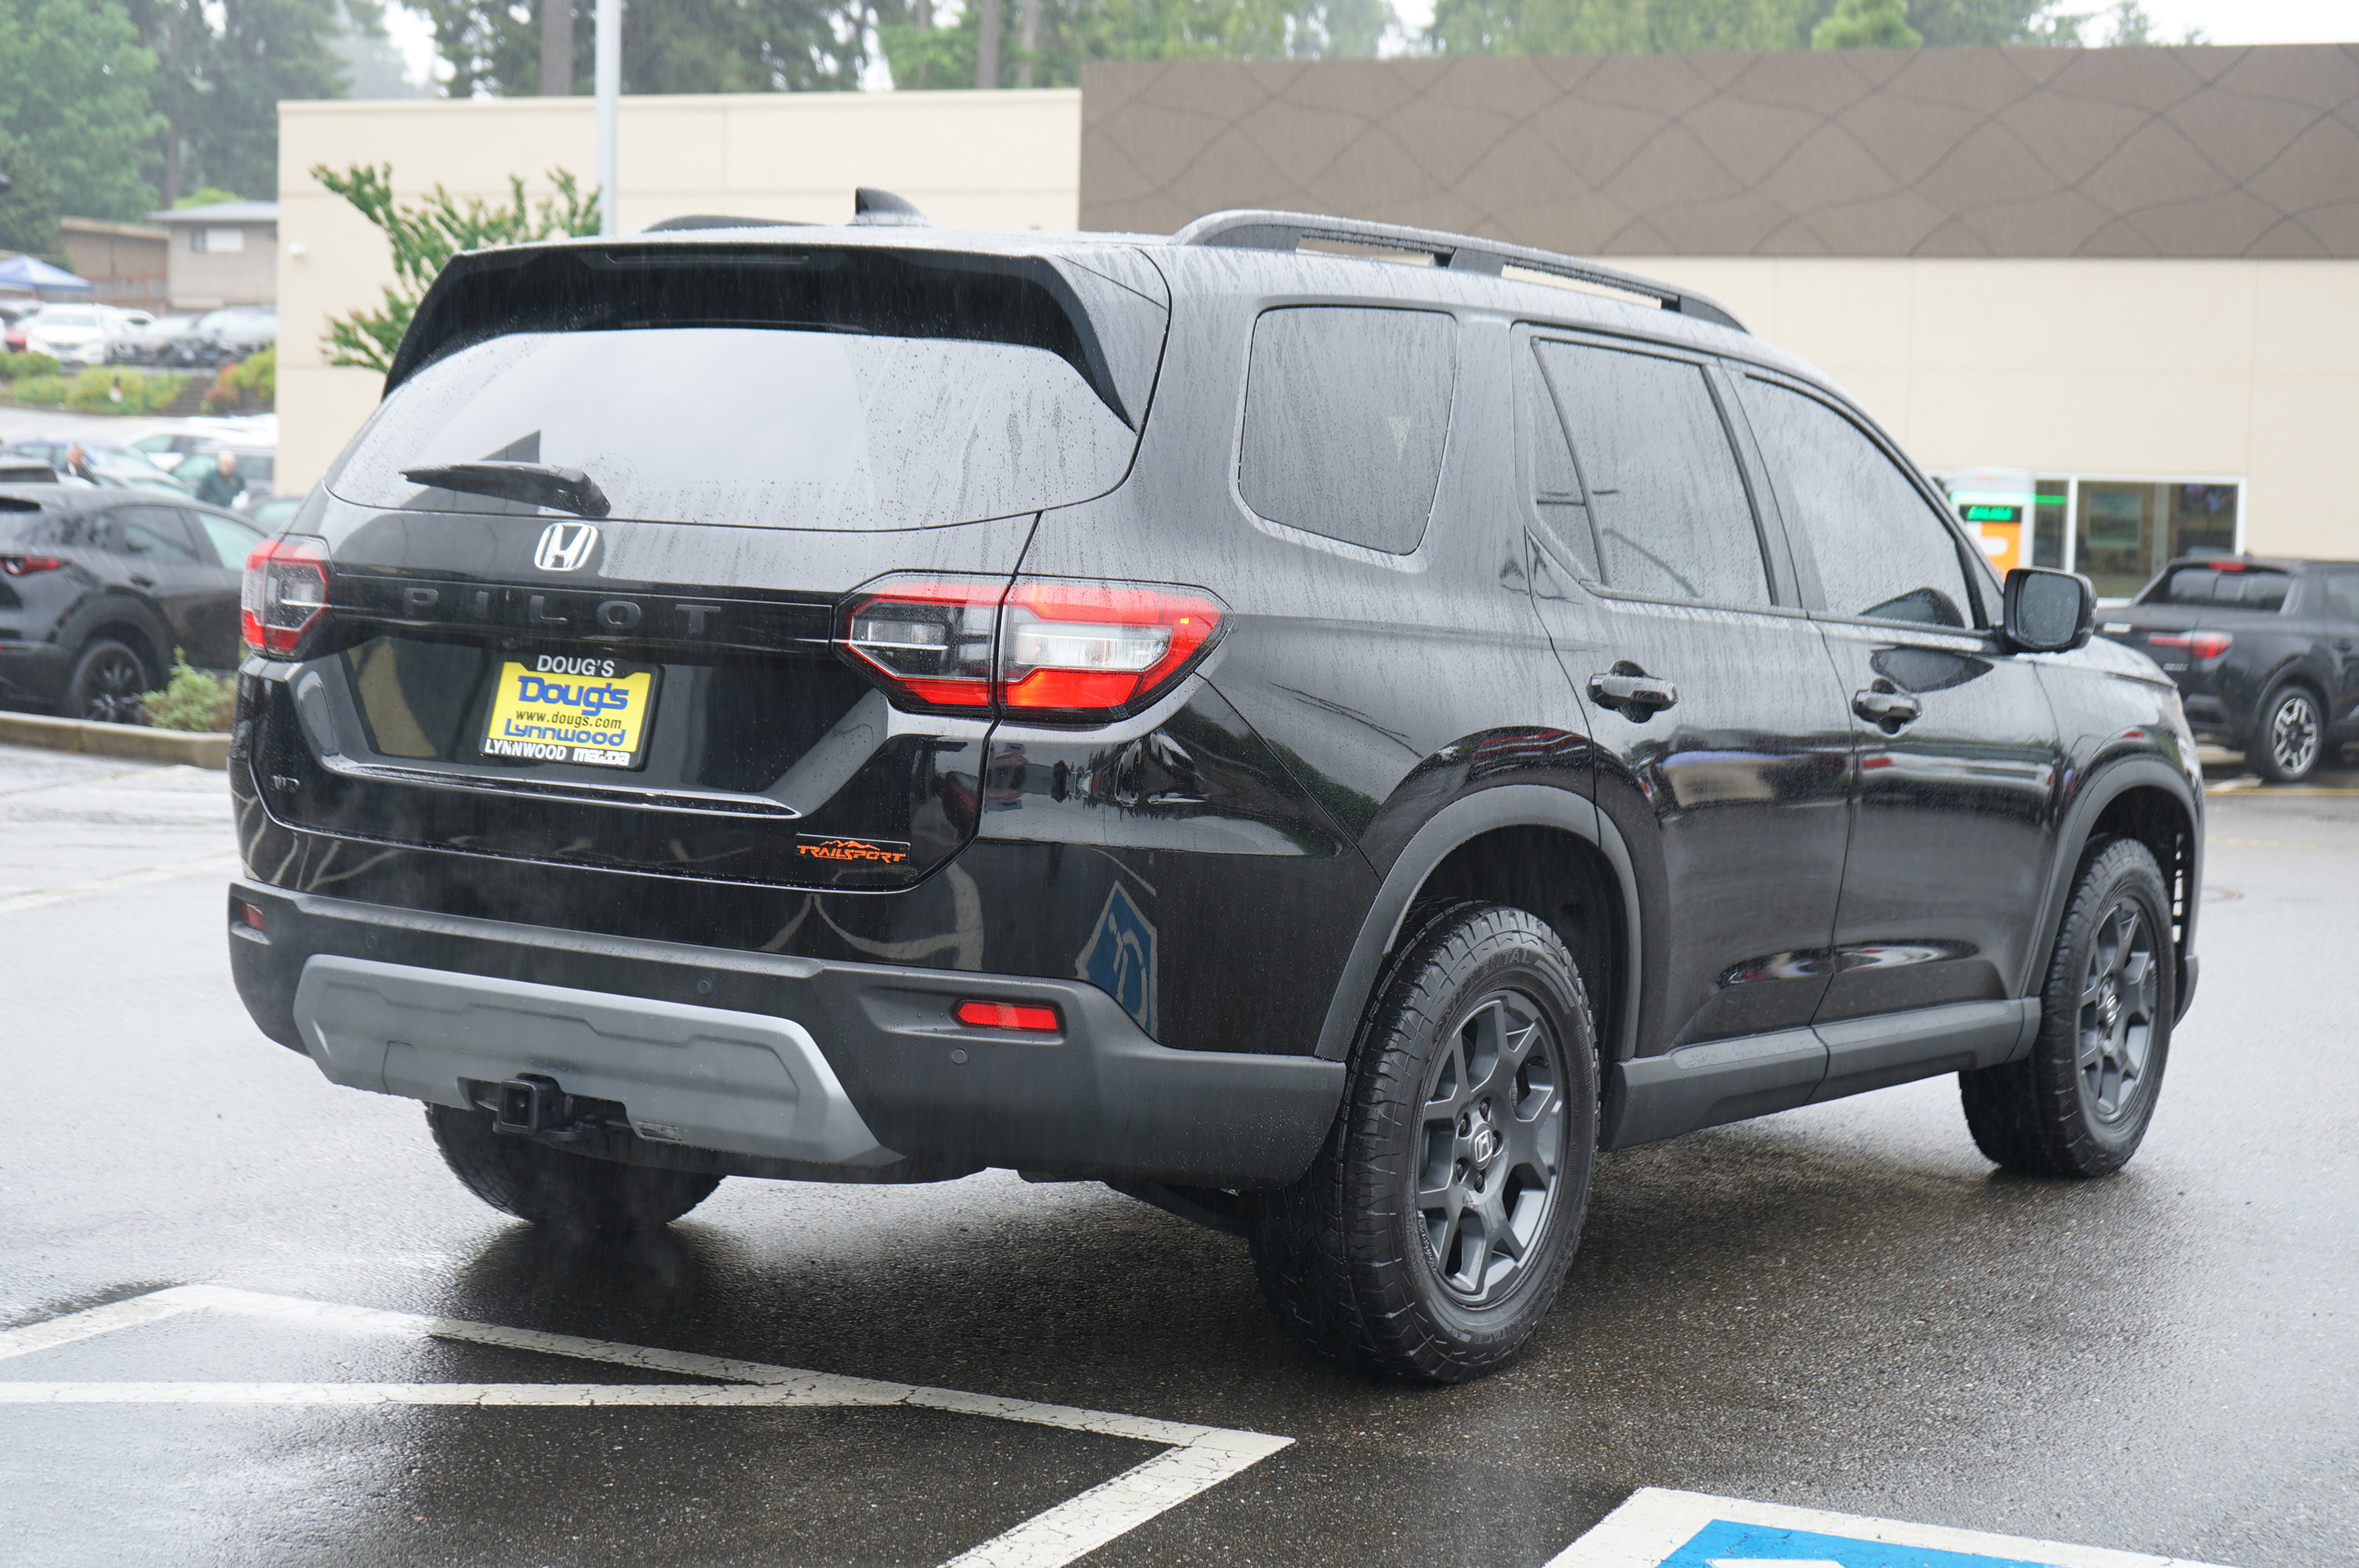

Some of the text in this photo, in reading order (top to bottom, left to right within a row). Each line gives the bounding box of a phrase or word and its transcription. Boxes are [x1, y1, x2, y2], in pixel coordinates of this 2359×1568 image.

[403, 587, 721, 634] PILOT
[536, 655, 615, 677] DOUG'S
[515, 710, 622, 729] www.dougs.com
[503, 718, 627, 746] Lynnwood
[484, 738, 567, 760] LYNNWOOD
[796, 844, 907, 863] TRAILSPORT
